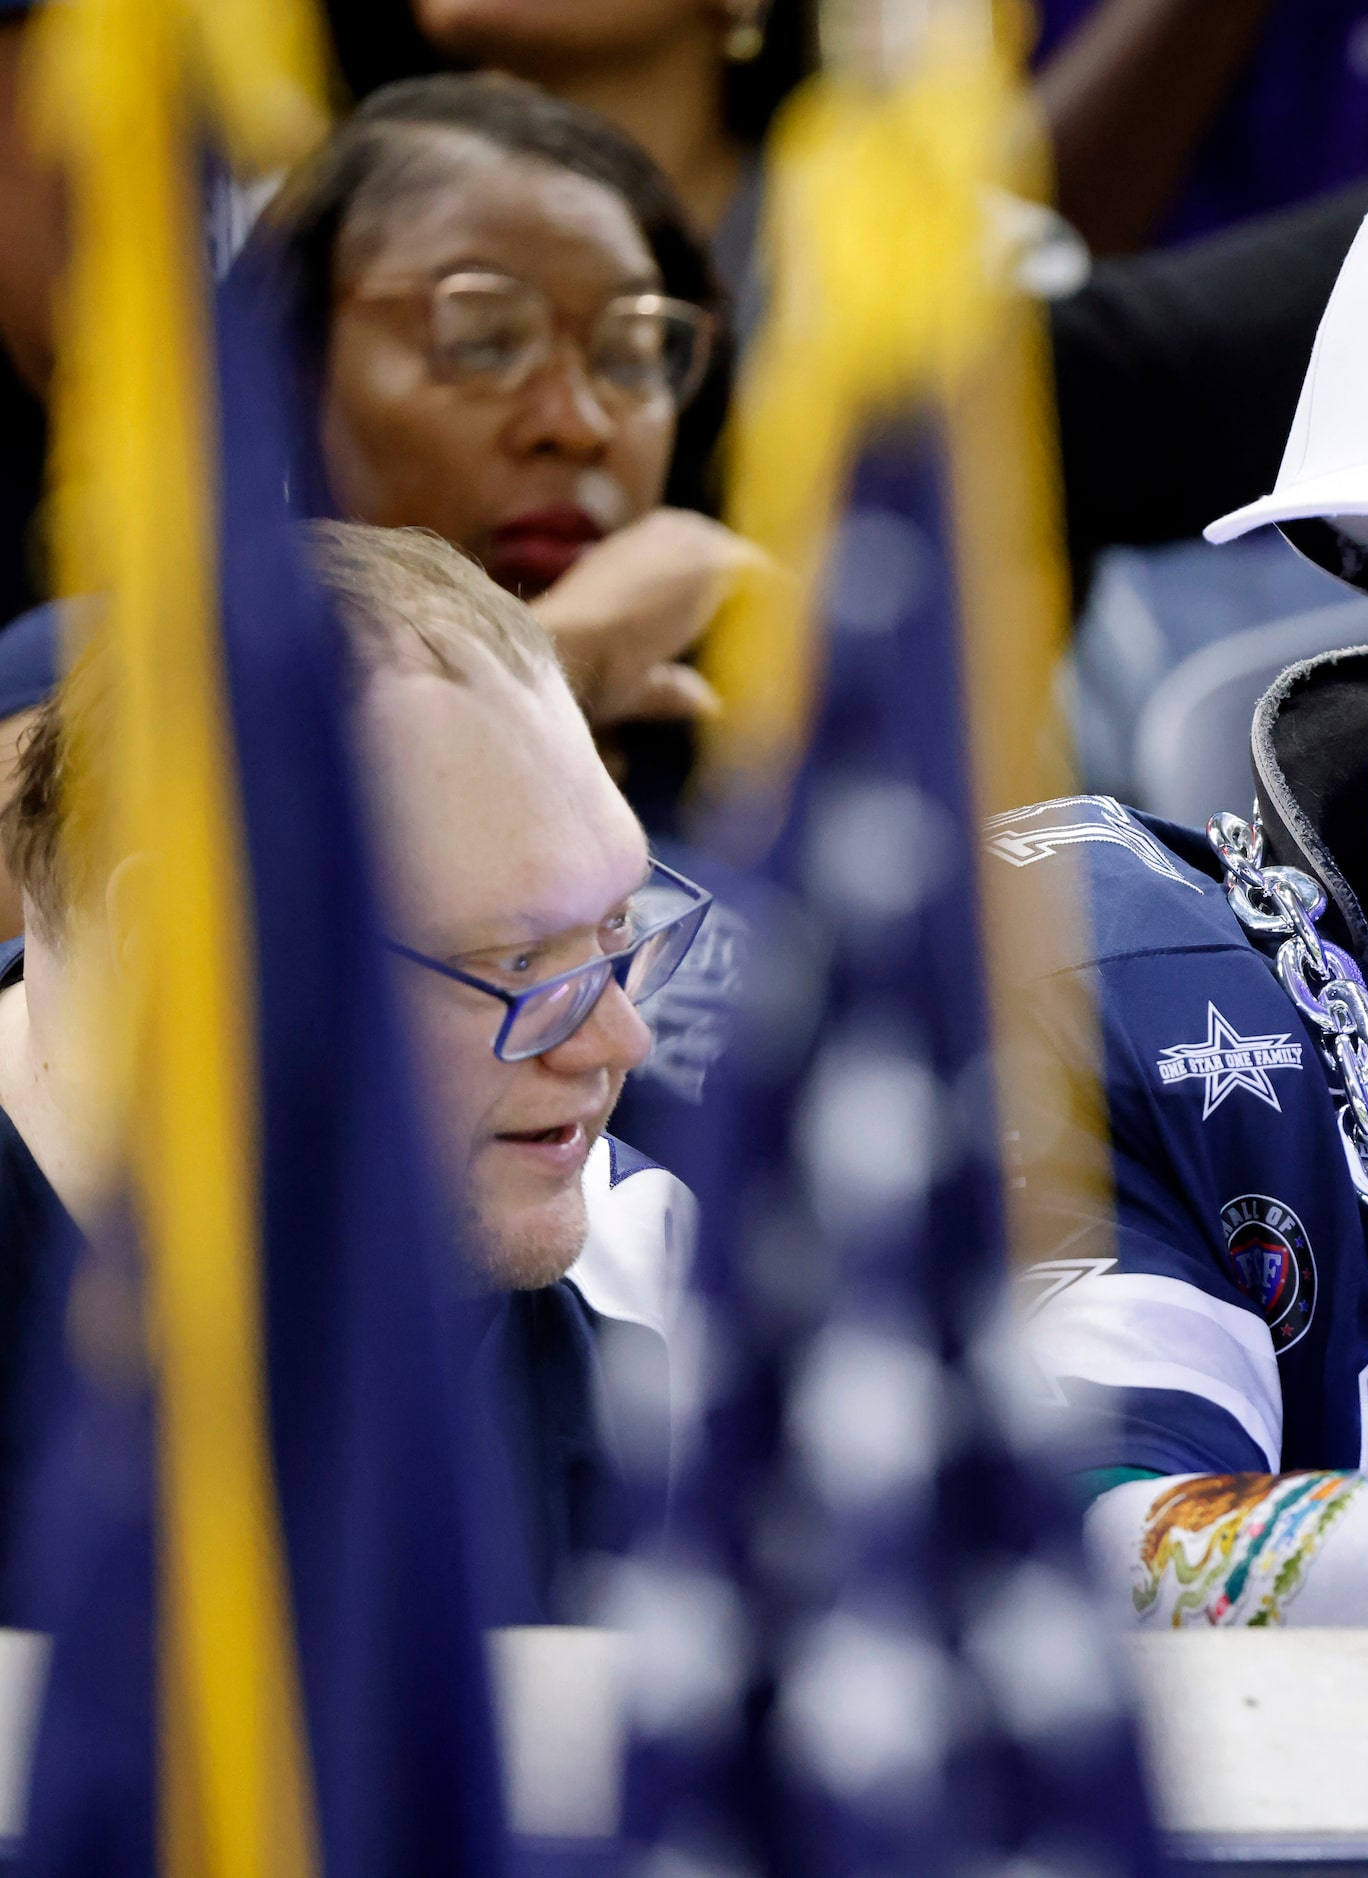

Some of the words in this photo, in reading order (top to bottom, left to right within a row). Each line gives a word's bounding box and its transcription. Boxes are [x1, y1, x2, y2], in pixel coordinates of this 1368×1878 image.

[1158, 1059, 1187, 1080] ONE
[1188, 1054, 1224, 1073] STAR
[1224, 1051, 1253, 1068] ONE
[1253, 1047, 1303, 1066] FAMILY
[1265, 1205, 1296, 1233] OF
